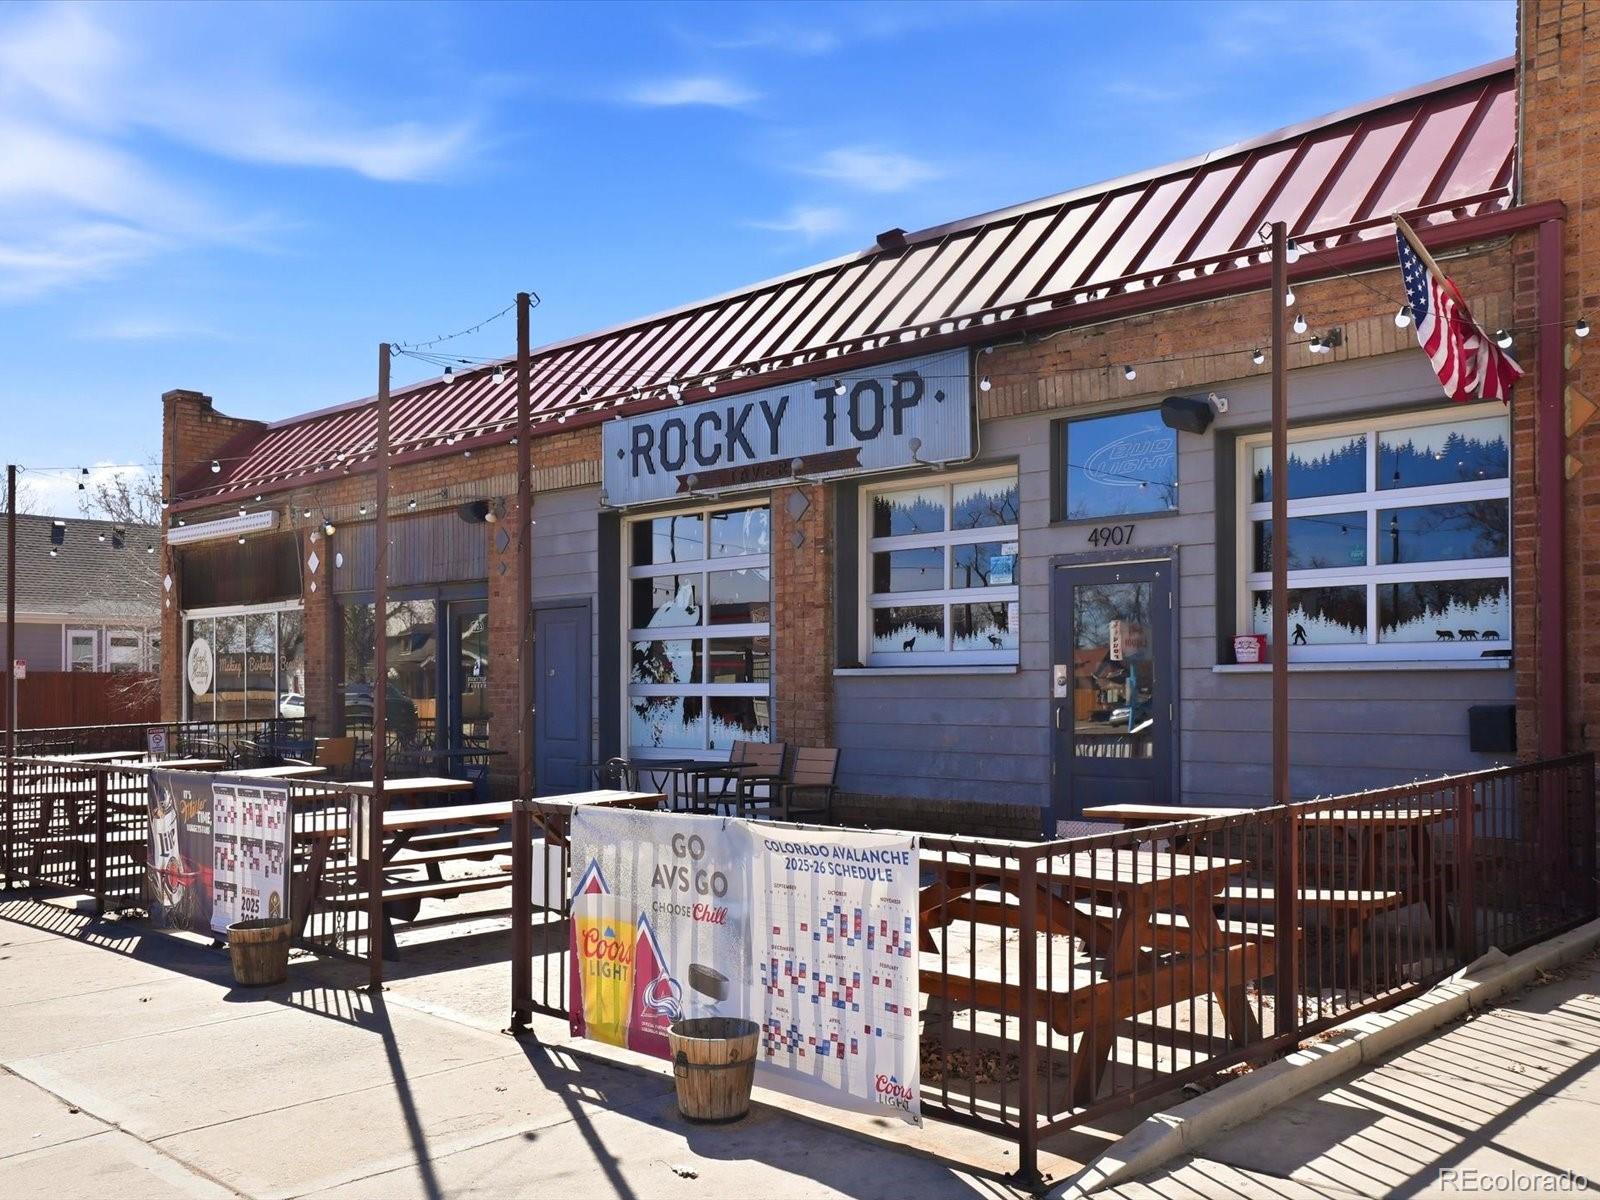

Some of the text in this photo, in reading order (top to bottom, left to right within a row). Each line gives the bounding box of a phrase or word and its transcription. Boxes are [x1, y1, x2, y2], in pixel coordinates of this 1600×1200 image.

[632, 370, 924, 477] ROCKY TOP
[1109, 438, 1174, 460] BUD
[1094, 452, 1176, 477] LIGHT
[1088, 524, 1135, 547] 4907
[671, 832, 706, 861] GO
[764, 838, 909, 866] COLORADO AVALANCHE
[651, 863, 729, 898] AVS GO
[785, 856, 893, 883] 2025-26 SCHEDULE
[241, 896, 260, 913] 2025
[652, 900, 729, 925] CHOOSE Chill
[582, 927, 634, 965] Coors
[590, 959, 628, 982] LIGHT
[875, 1074, 914, 1100] Coors
